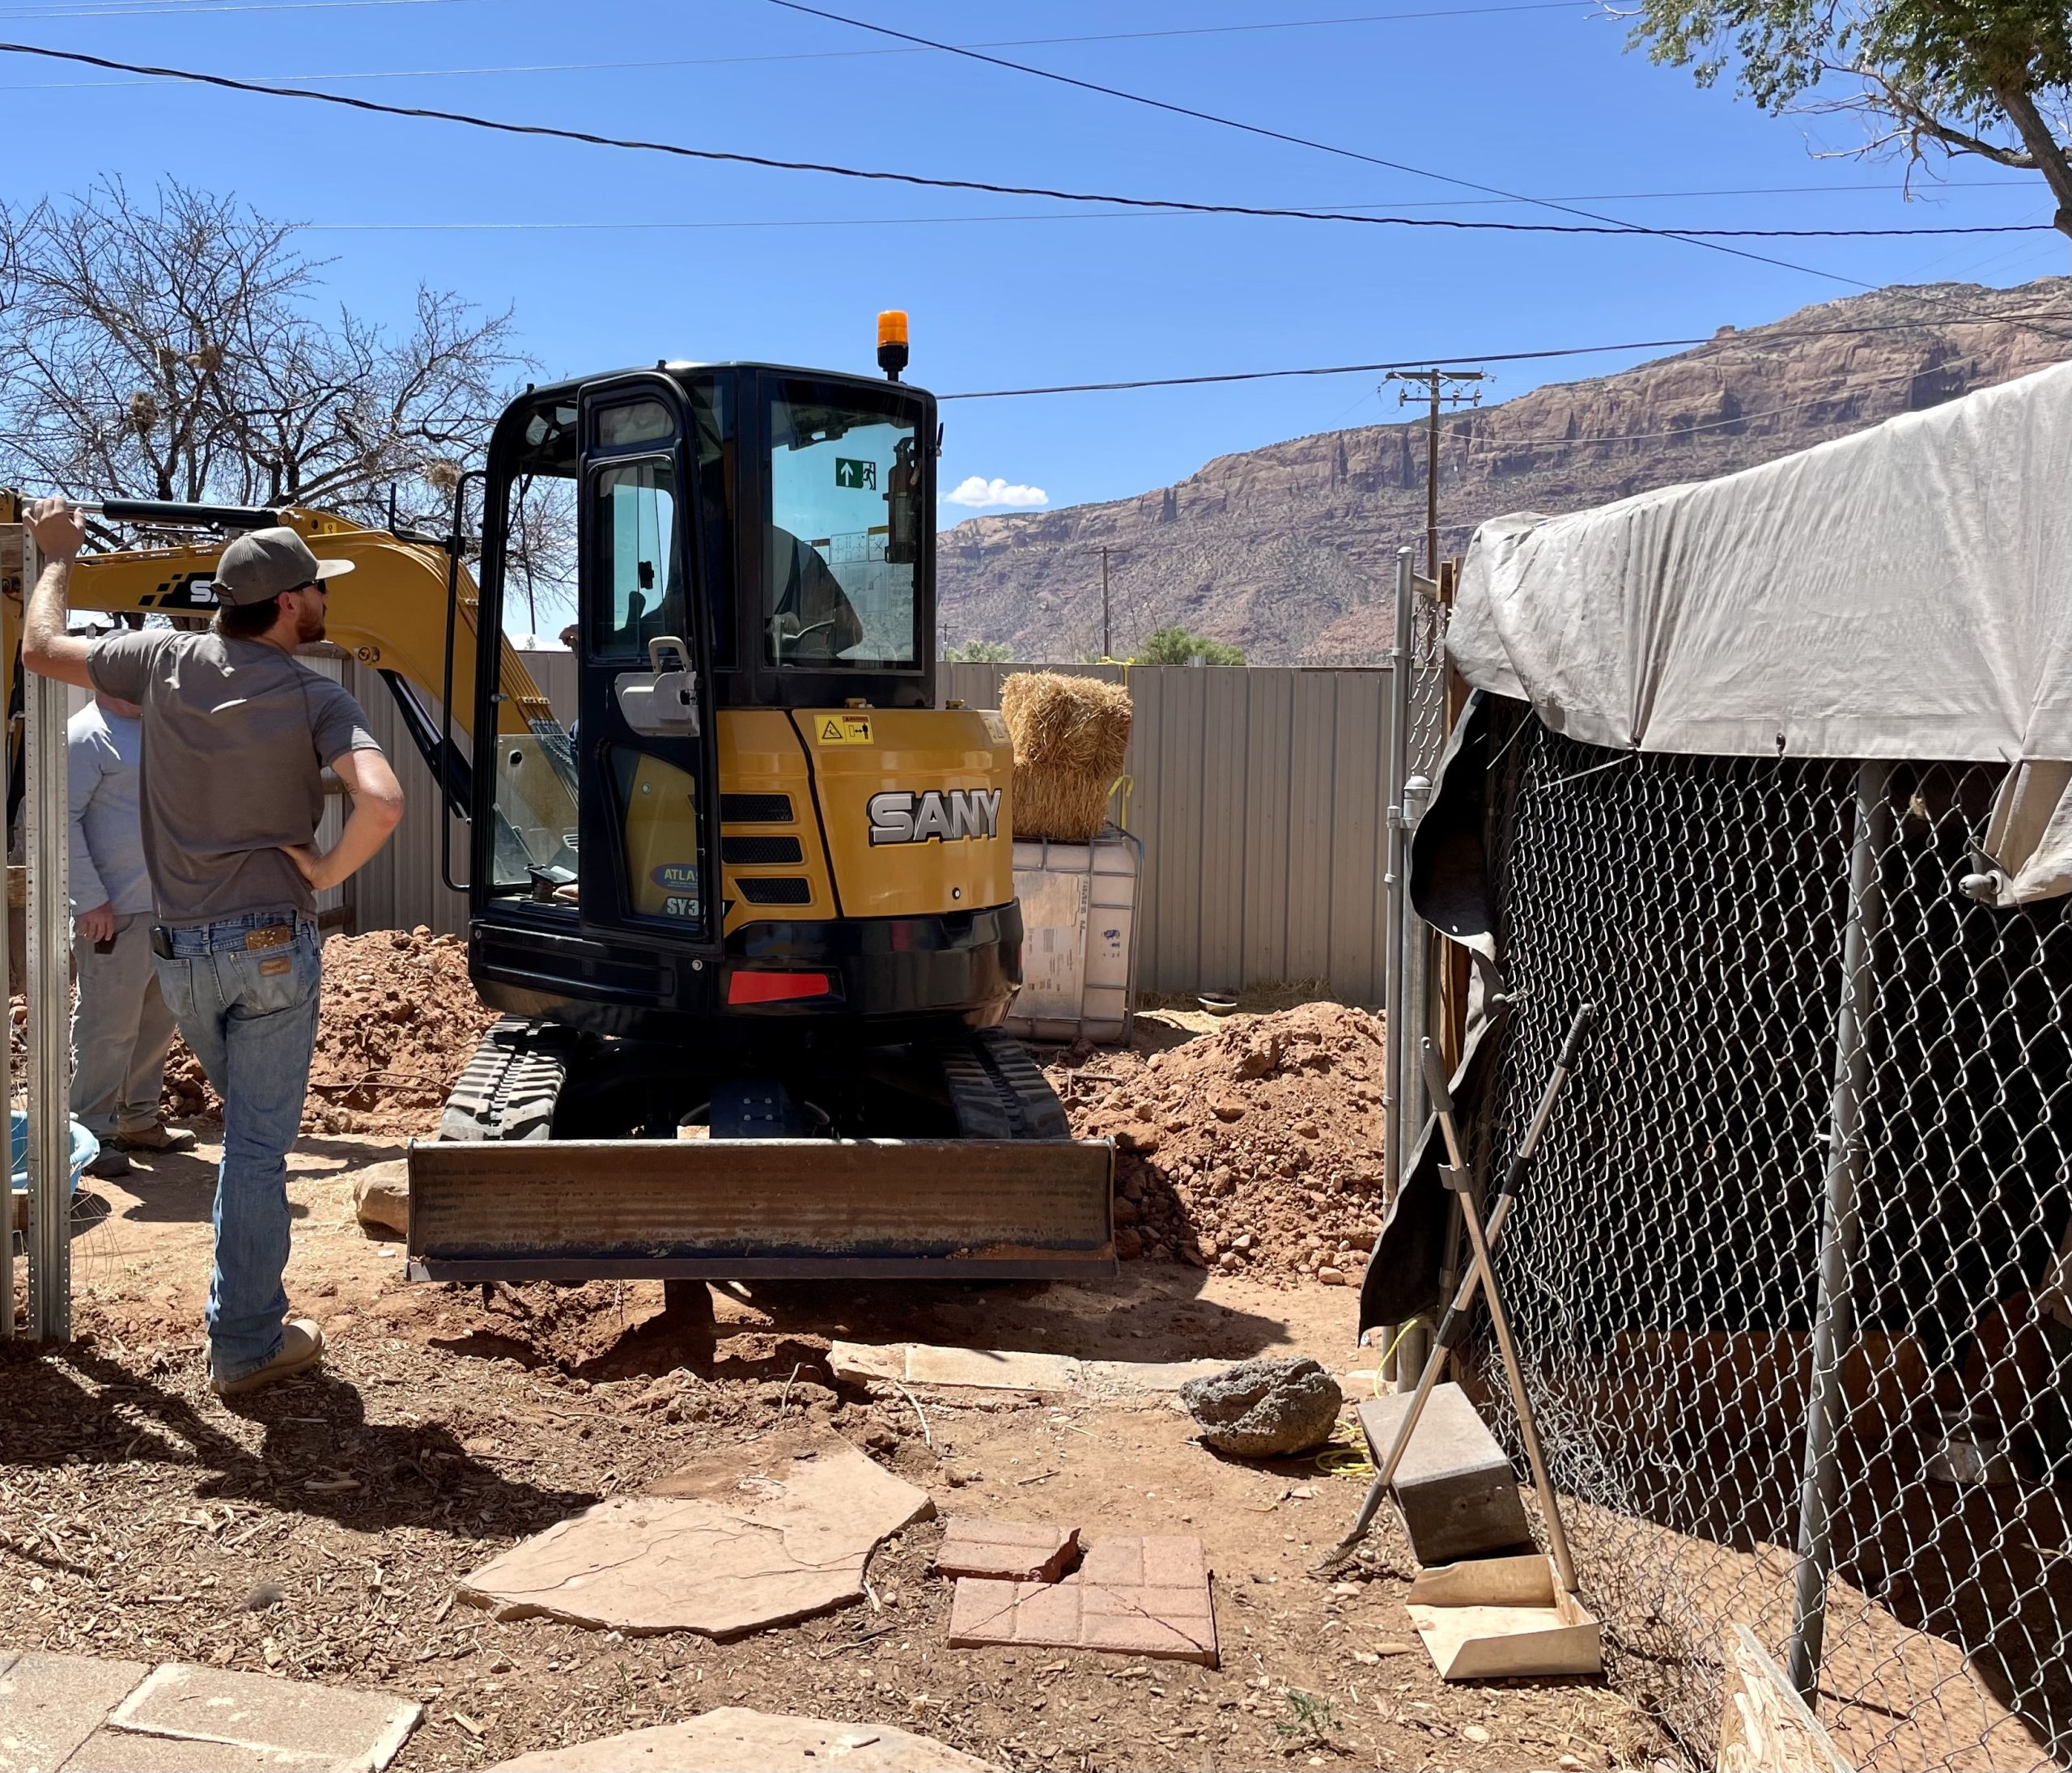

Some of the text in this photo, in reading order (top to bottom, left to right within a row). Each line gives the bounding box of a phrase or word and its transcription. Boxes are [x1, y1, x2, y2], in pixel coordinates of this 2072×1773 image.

[190, 579, 219, 603] S
[868, 788, 1002, 843] SANY
[664, 868, 698, 881] ATLA
